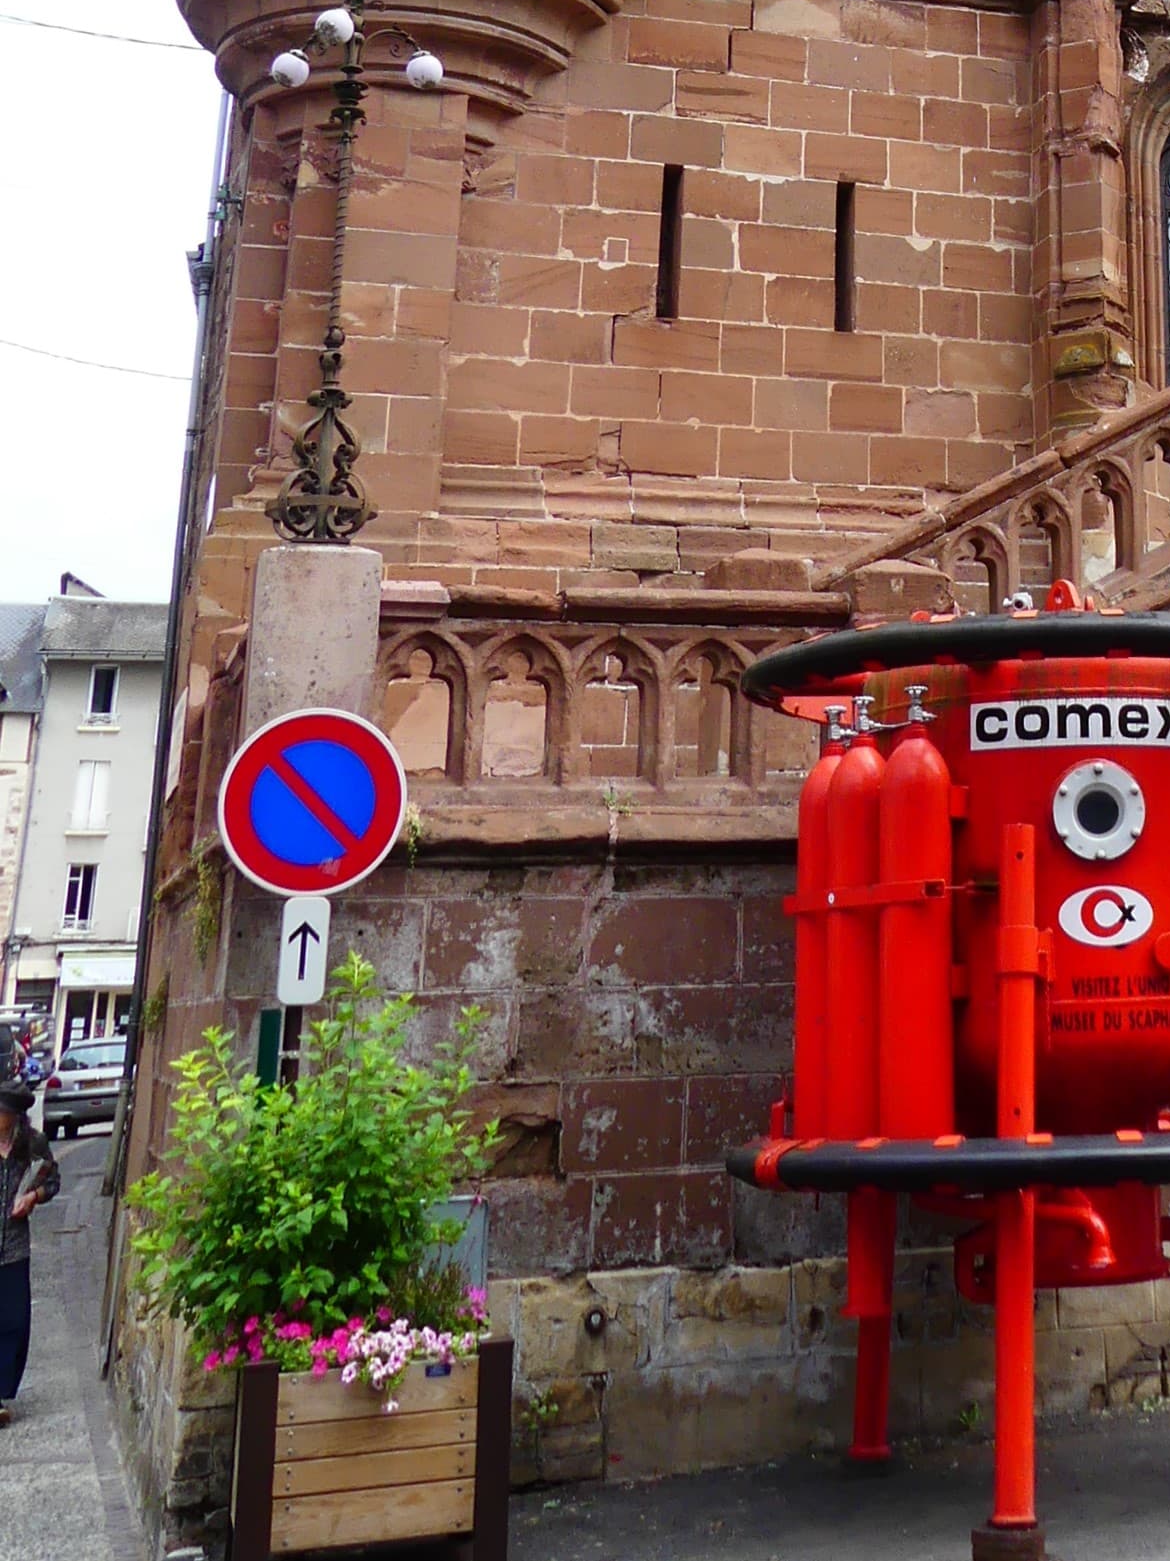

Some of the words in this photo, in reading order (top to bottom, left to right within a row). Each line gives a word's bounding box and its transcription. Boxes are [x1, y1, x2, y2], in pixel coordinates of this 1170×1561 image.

[1072, 976, 1120, 997] VISITEZ
[1051, 1011, 1095, 1032] MUSEE
[1103, 1010, 1122, 1031] DU
